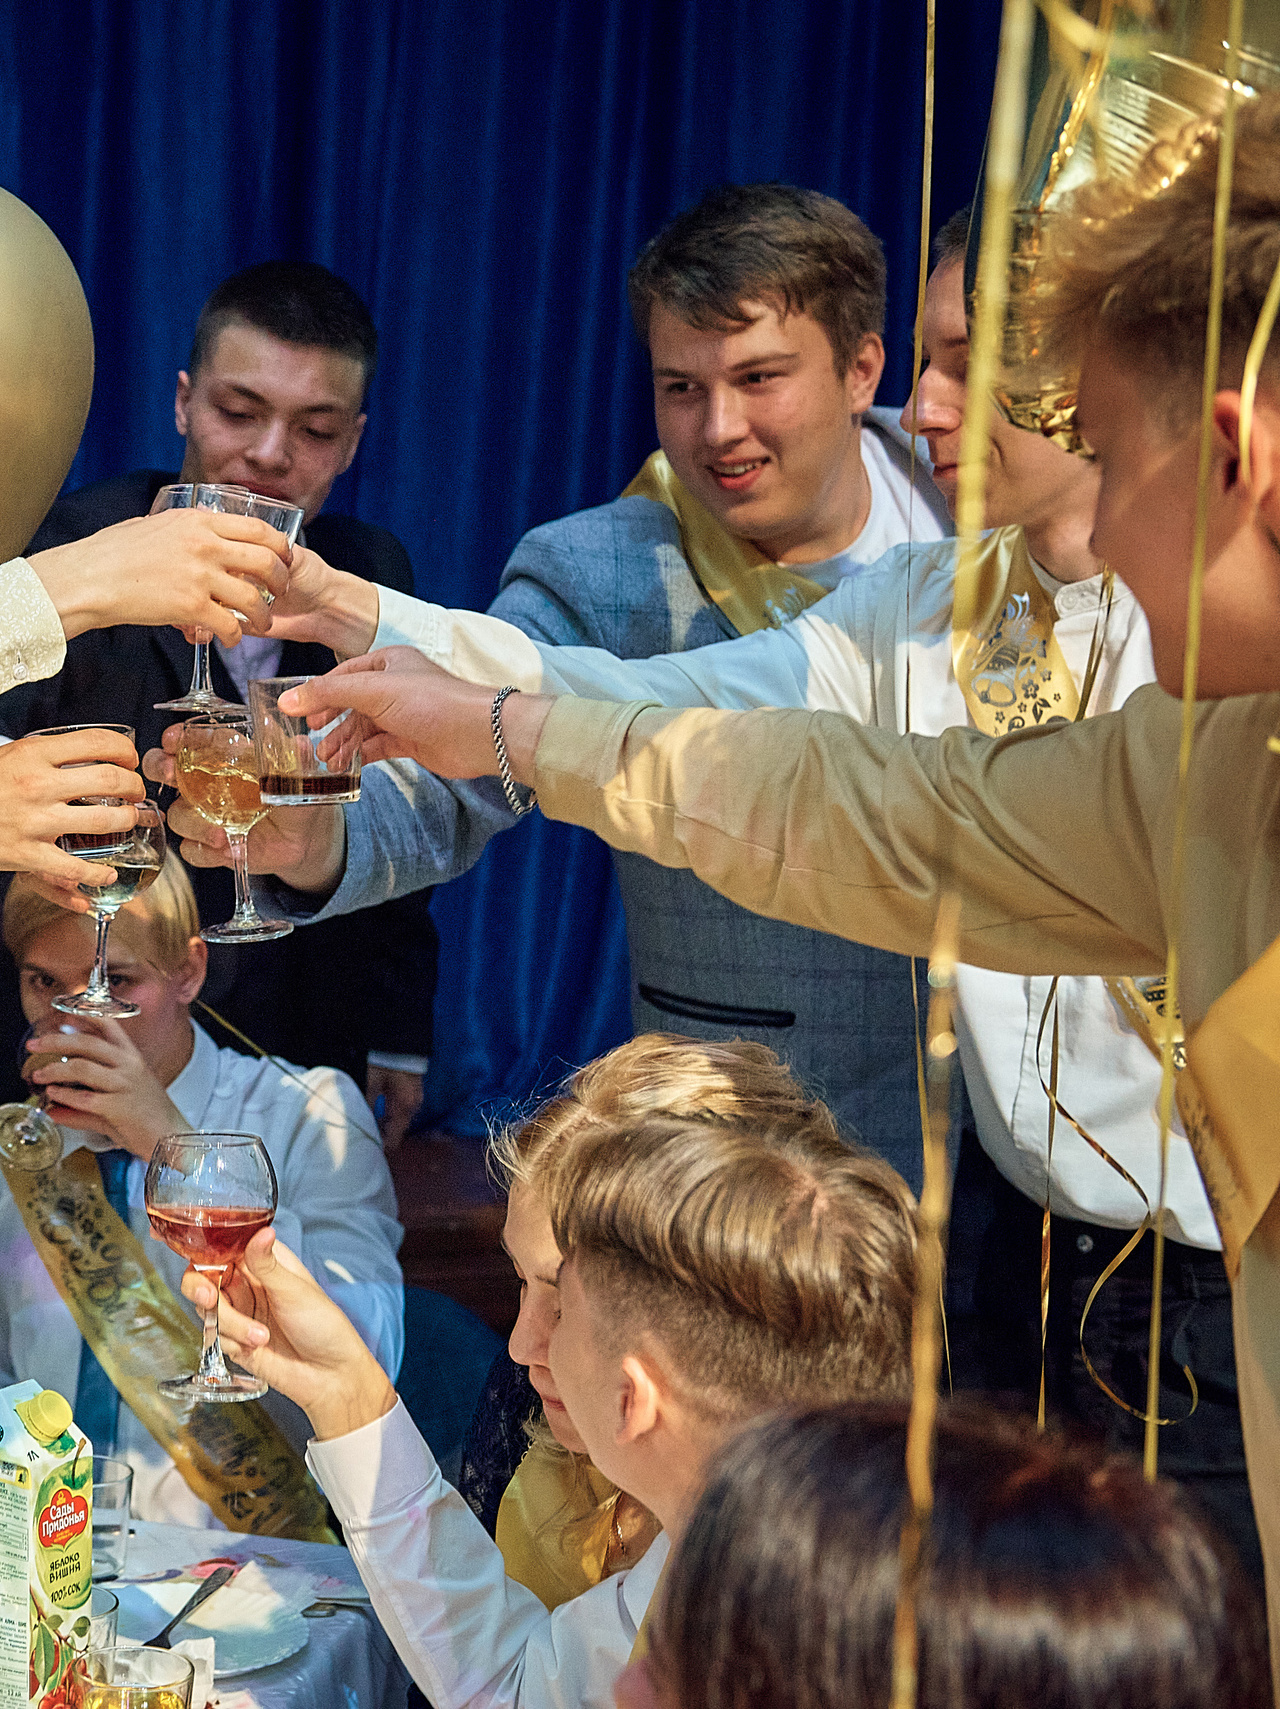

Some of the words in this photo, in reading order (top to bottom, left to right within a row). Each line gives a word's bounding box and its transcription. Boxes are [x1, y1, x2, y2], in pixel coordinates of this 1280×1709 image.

[49, 1502, 74, 1521] Сады
[42, 1510, 85, 1538] Придонья
[49, 1552, 80, 1572] ЯБЛОКО
[49, 1561, 81, 1583] ВИШНЯ
[50, 1586, 68, 1603] 100%
[67, 1581, 81, 1596] СОК
